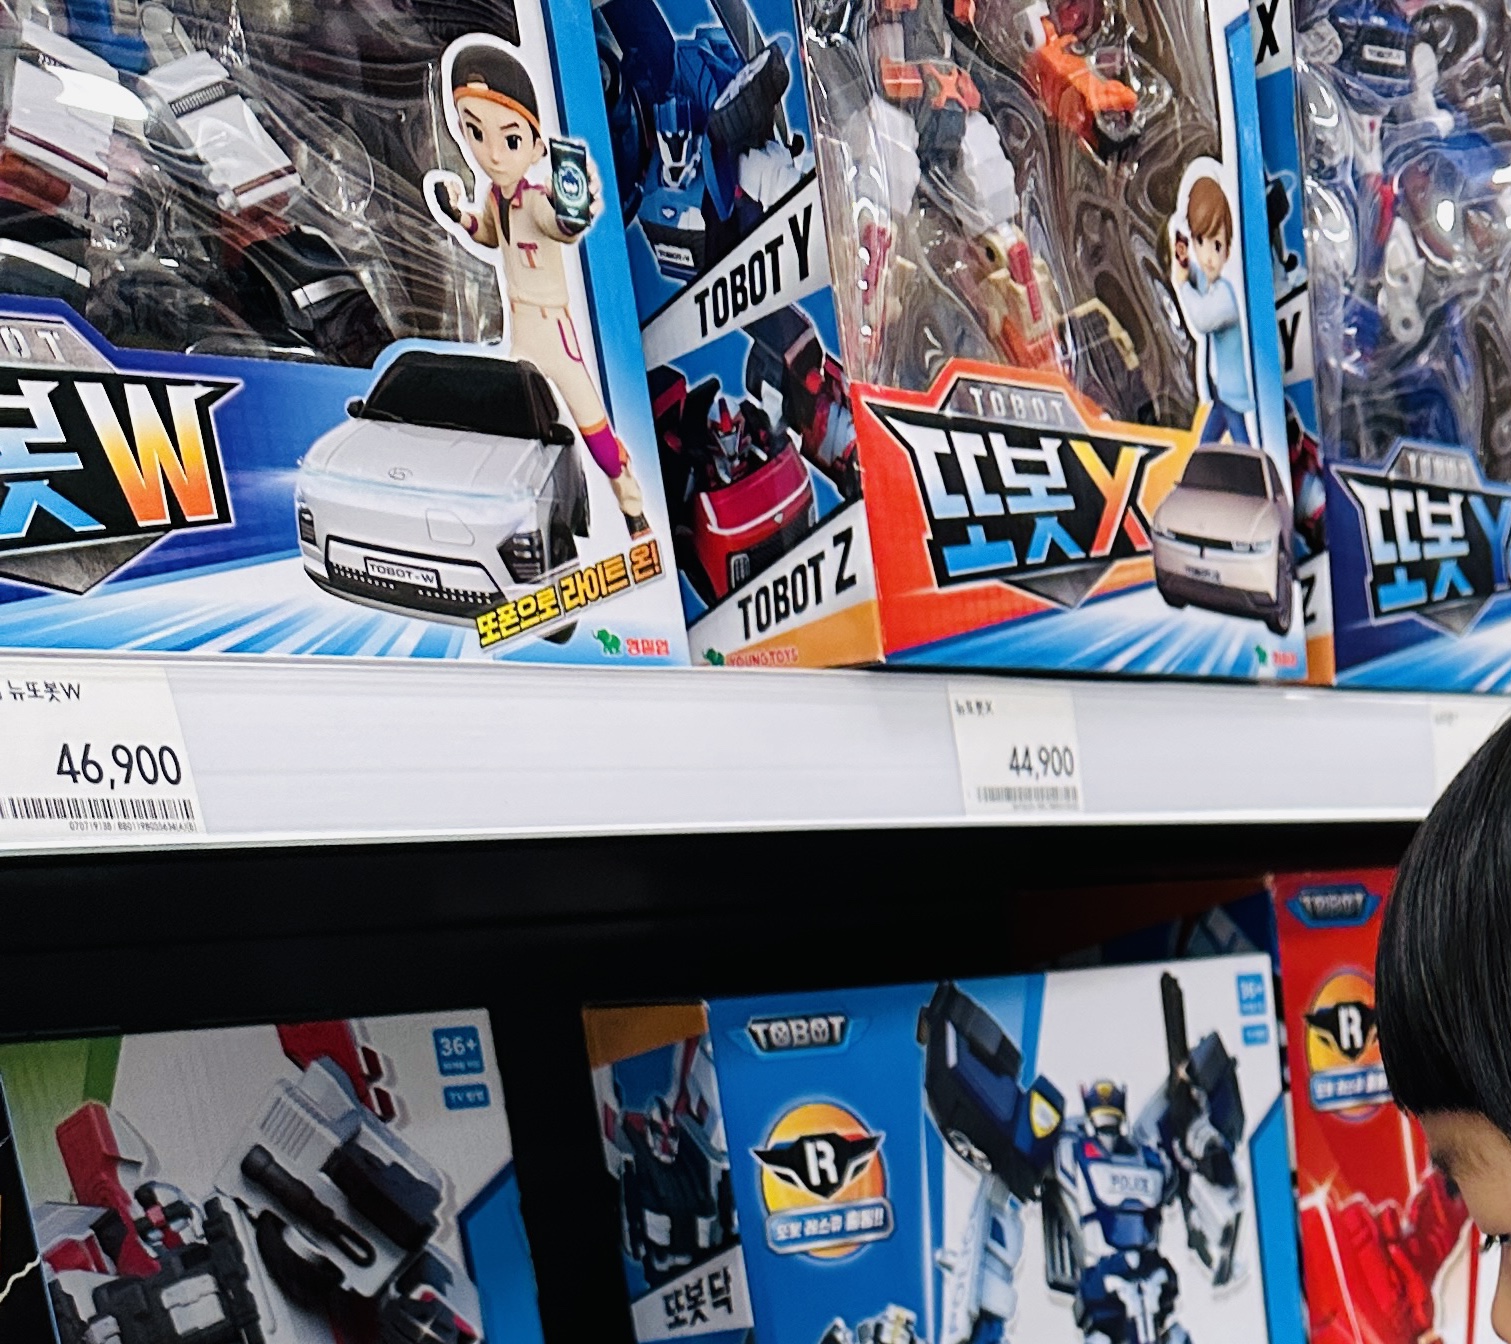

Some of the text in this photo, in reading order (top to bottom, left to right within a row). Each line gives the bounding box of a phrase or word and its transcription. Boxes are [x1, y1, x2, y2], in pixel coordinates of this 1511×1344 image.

[694, 203, 813, 337] TOBOT Y
[1278, 311, 1301, 373] Y
[969, 386, 1066, 425] TOBOT
[476, 539, 662, 648] 또폰으로 라이트 온!
[738, 526, 857, 640] TOBOT Z
[729, 647, 798, 666] YOUNG TOYS
[8, 680, 81, 703] 뉴또봇W
[57, 743, 182, 789] 46,900
[1009, 746, 1074, 780] 44,900
[440, 1036, 477, 1056] 36+
[750, 1015, 846, 1051] TOBOT
